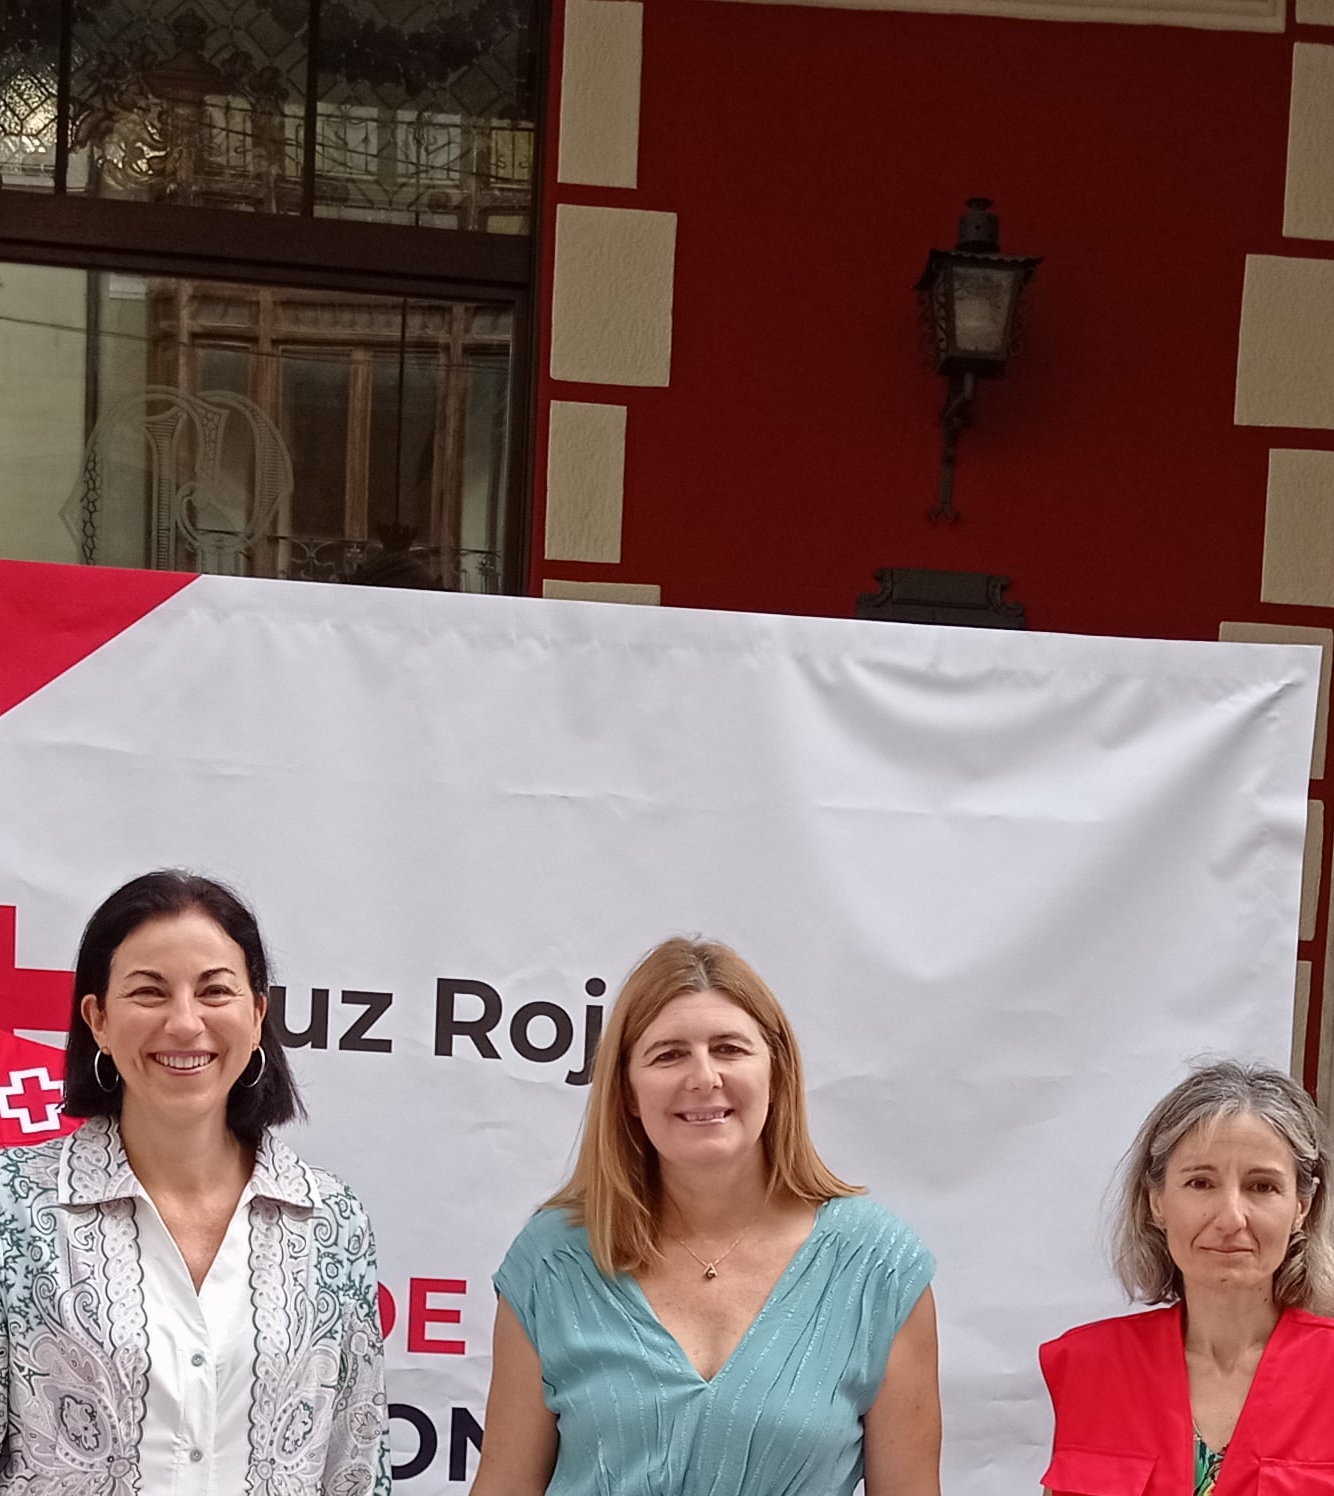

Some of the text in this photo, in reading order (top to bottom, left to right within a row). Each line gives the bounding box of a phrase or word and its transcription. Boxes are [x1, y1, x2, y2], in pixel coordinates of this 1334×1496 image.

[269, 977, 607, 1086] uz Roj
[387, 1403, 484, 1481] ON
